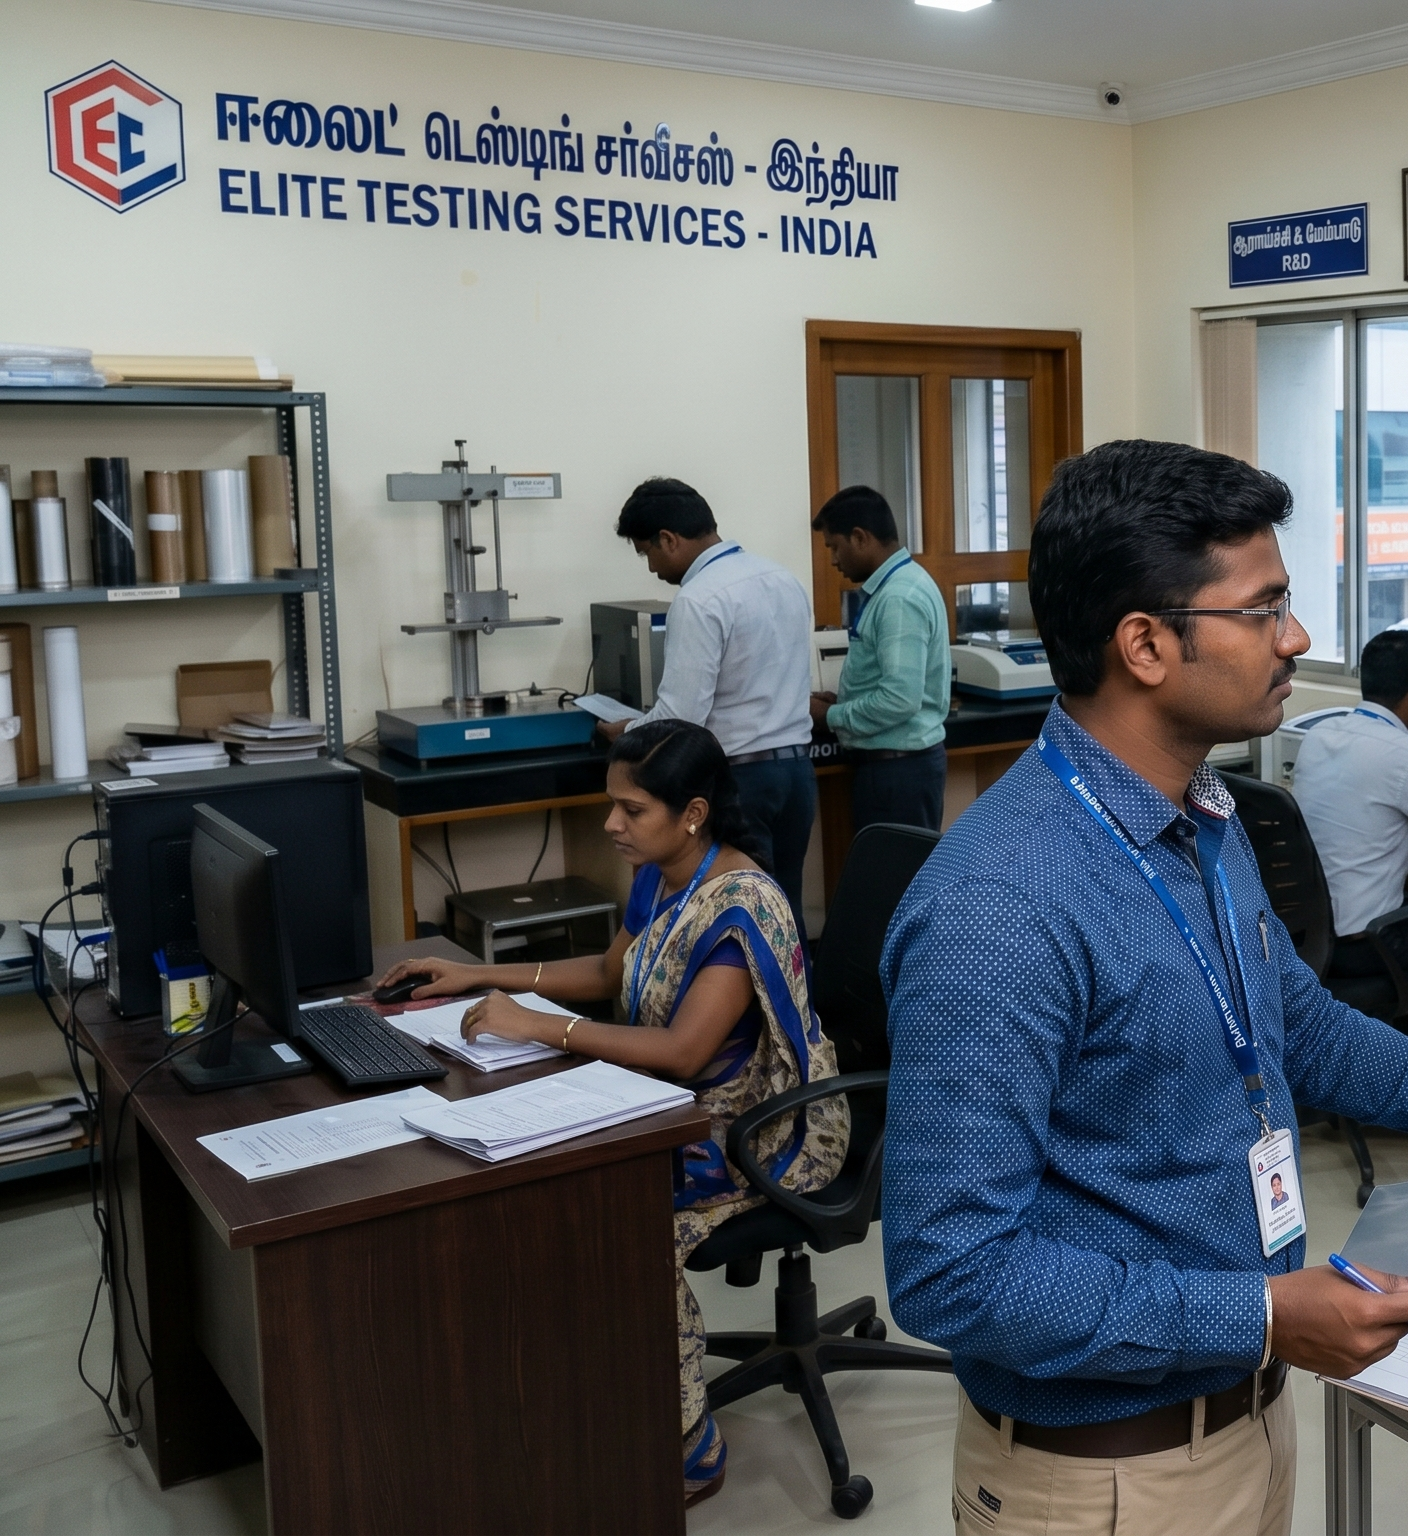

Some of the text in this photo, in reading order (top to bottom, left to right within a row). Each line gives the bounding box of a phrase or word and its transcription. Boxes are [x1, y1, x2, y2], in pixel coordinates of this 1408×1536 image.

[766, 138, 899, 210] இந்தியா
[218, 168, 347, 220] ELITE
[357, 179, 541, 234] TESTING
[554, 195, 746, 249] SERVICES
[780, 215, 877, 259] INDIA
[1293, 226, 1303, 246] &
[1282, 252, 1311, 272] R&D
